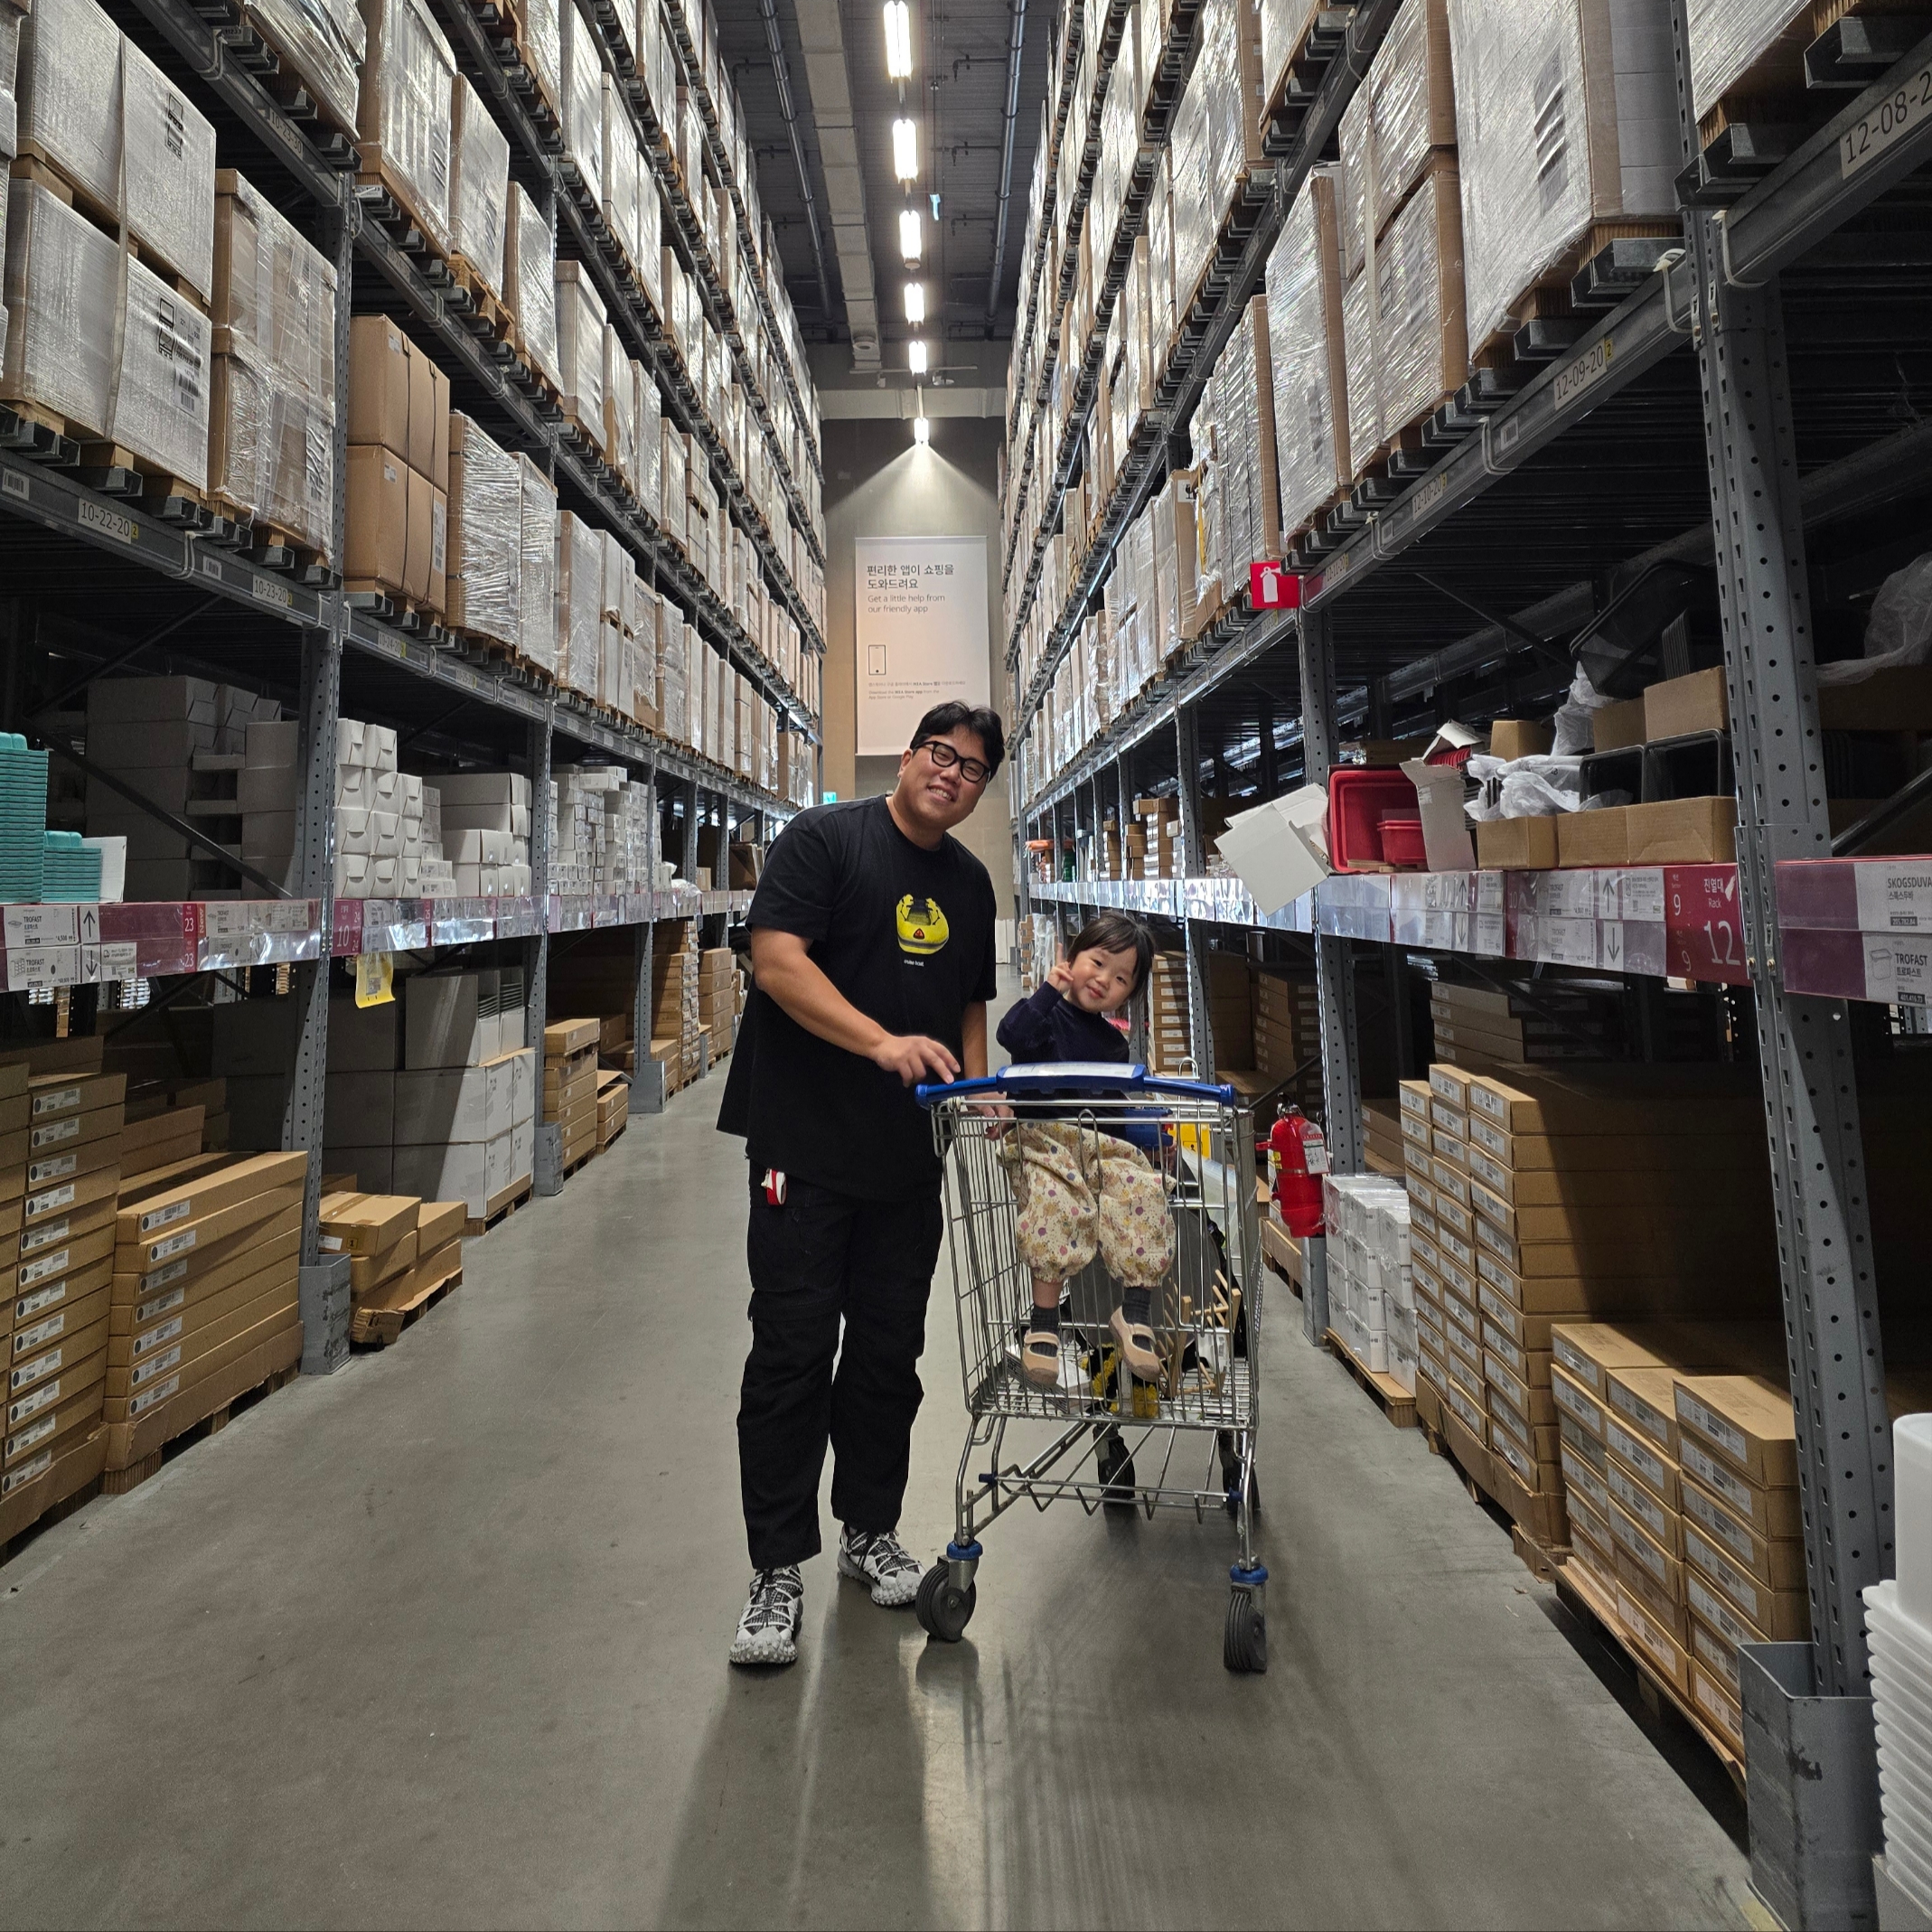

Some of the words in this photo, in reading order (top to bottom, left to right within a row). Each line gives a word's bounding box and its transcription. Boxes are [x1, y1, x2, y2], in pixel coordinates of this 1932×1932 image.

[1557, 345, 1603, 400] 12-09-20
[1606, 343, 1611, 357] 2
[1414, 475, 1441, 513] 12-10-20
[82, 502, 130, 537] 10-22-20
[133, 526, 137, 536] 2
[867, 565, 897, 577] 편리한
[900, 565, 920, 576] 앱이
[924, 564, 954, 576] 쇼핑을
[255, 579, 286, 603] 10-23-20
[868, 578, 918, 590] 도와드려요
[868, 595, 882, 604] Get
[890, 594, 906, 602] little
[908, 594, 924, 604] help
[926, 593, 945, 602] from
[868, 605, 882, 614] our
[884, 605, 912, 614] friendly
[914, 605, 929, 614] app
[1703, 877, 1725, 894] 진열대
[1888, 877, 1932, 888] SKOGSDUVA
[1509, 891, 1518, 908] 10
[1674, 894, 1681, 916] 9
[1708, 897, 1721, 908] Rack
[354, 911, 361, 923] 24
[184, 918, 193, 932] 23
[337, 925, 349, 947] 10
[1703, 920, 1741, 966] 12
[352, 940, 359, 952] 24
[184, 953, 193, 967] 23
[1682, 950, 1692, 971] 9
[1895, 953, 1928, 966] TROFAST
[1897, 967, 1922, 978] 트로파스트
